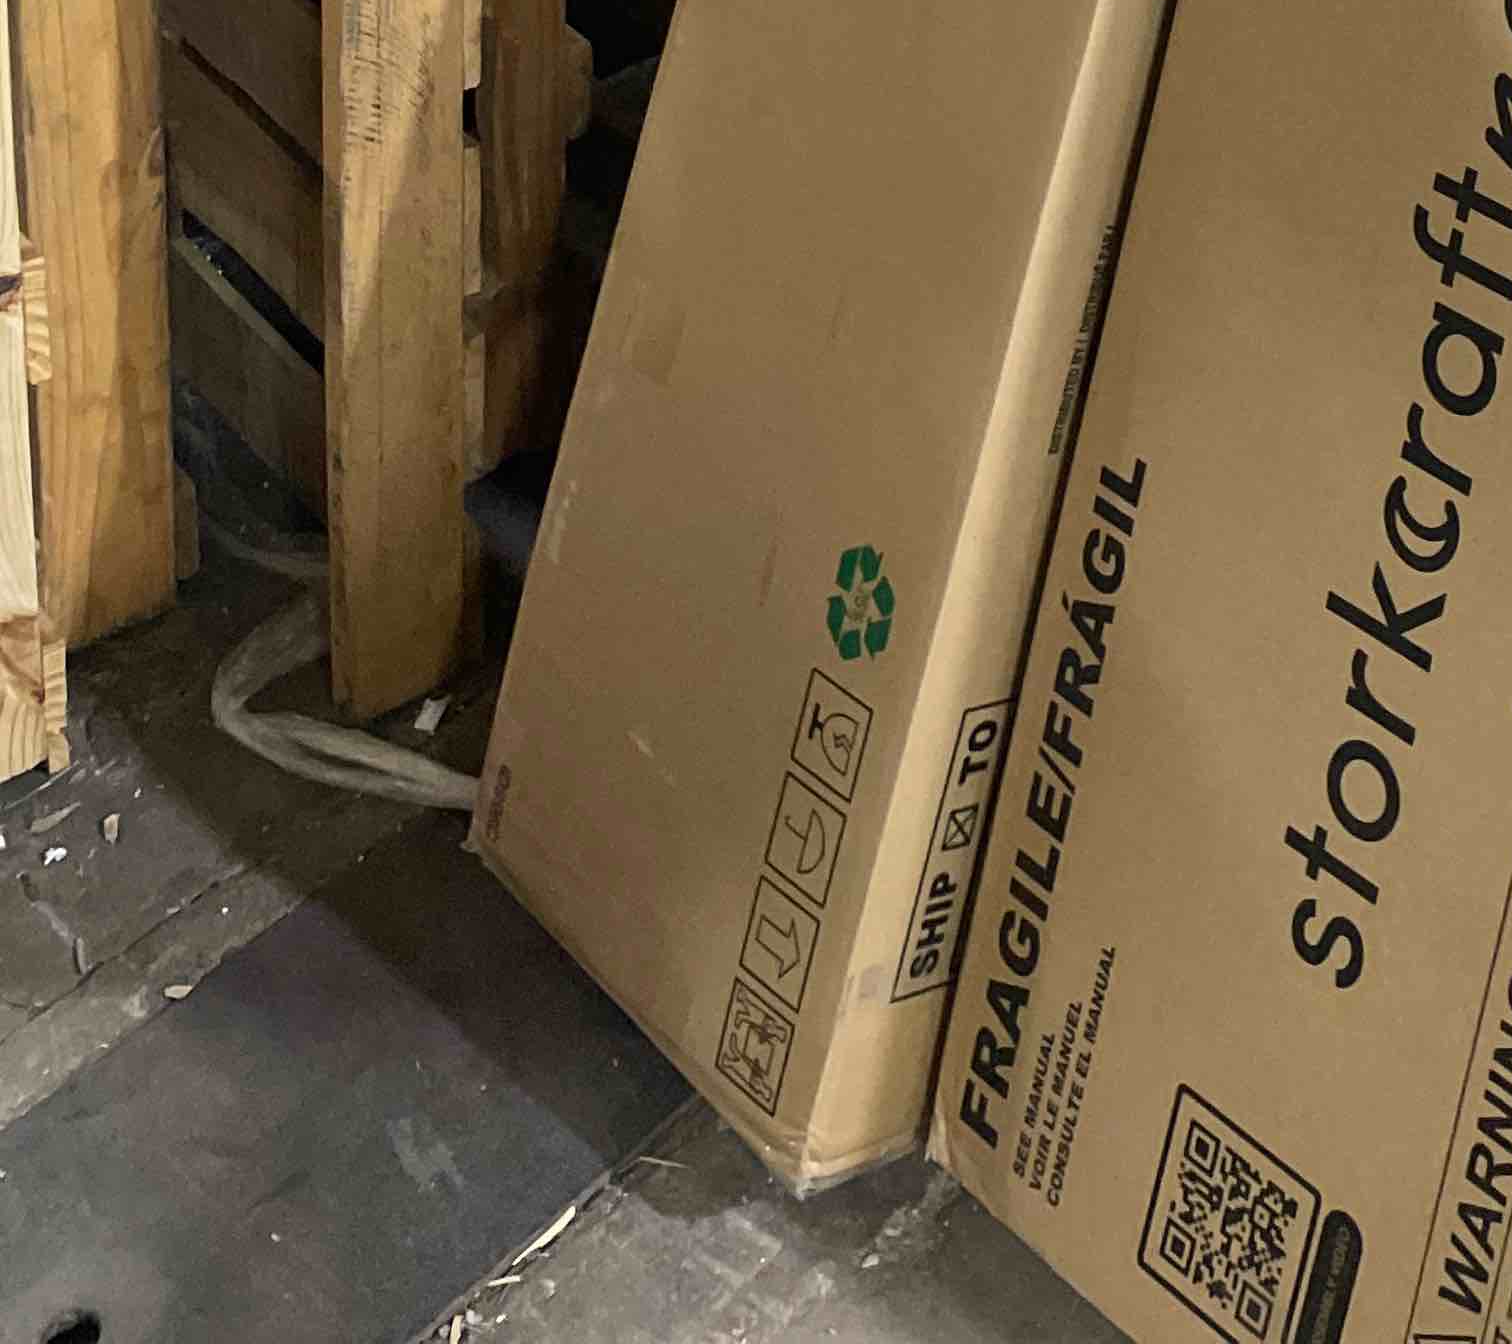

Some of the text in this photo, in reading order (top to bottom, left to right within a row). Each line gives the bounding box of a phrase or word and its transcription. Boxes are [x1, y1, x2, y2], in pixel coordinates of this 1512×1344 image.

[908, 714, 999, 979] SHIP TO
[958, 458, 1147, 1149] FRAGILE/FRÁGIL
[1011, 1031, 1056, 1179] SEE MANUAL
[1028, 1136, 1050, 1192] VOIR
[1051, 1000, 1083, 1096] MANUEL
[1046, 944, 1117, 1207] CONSULTE EL MANUAL
